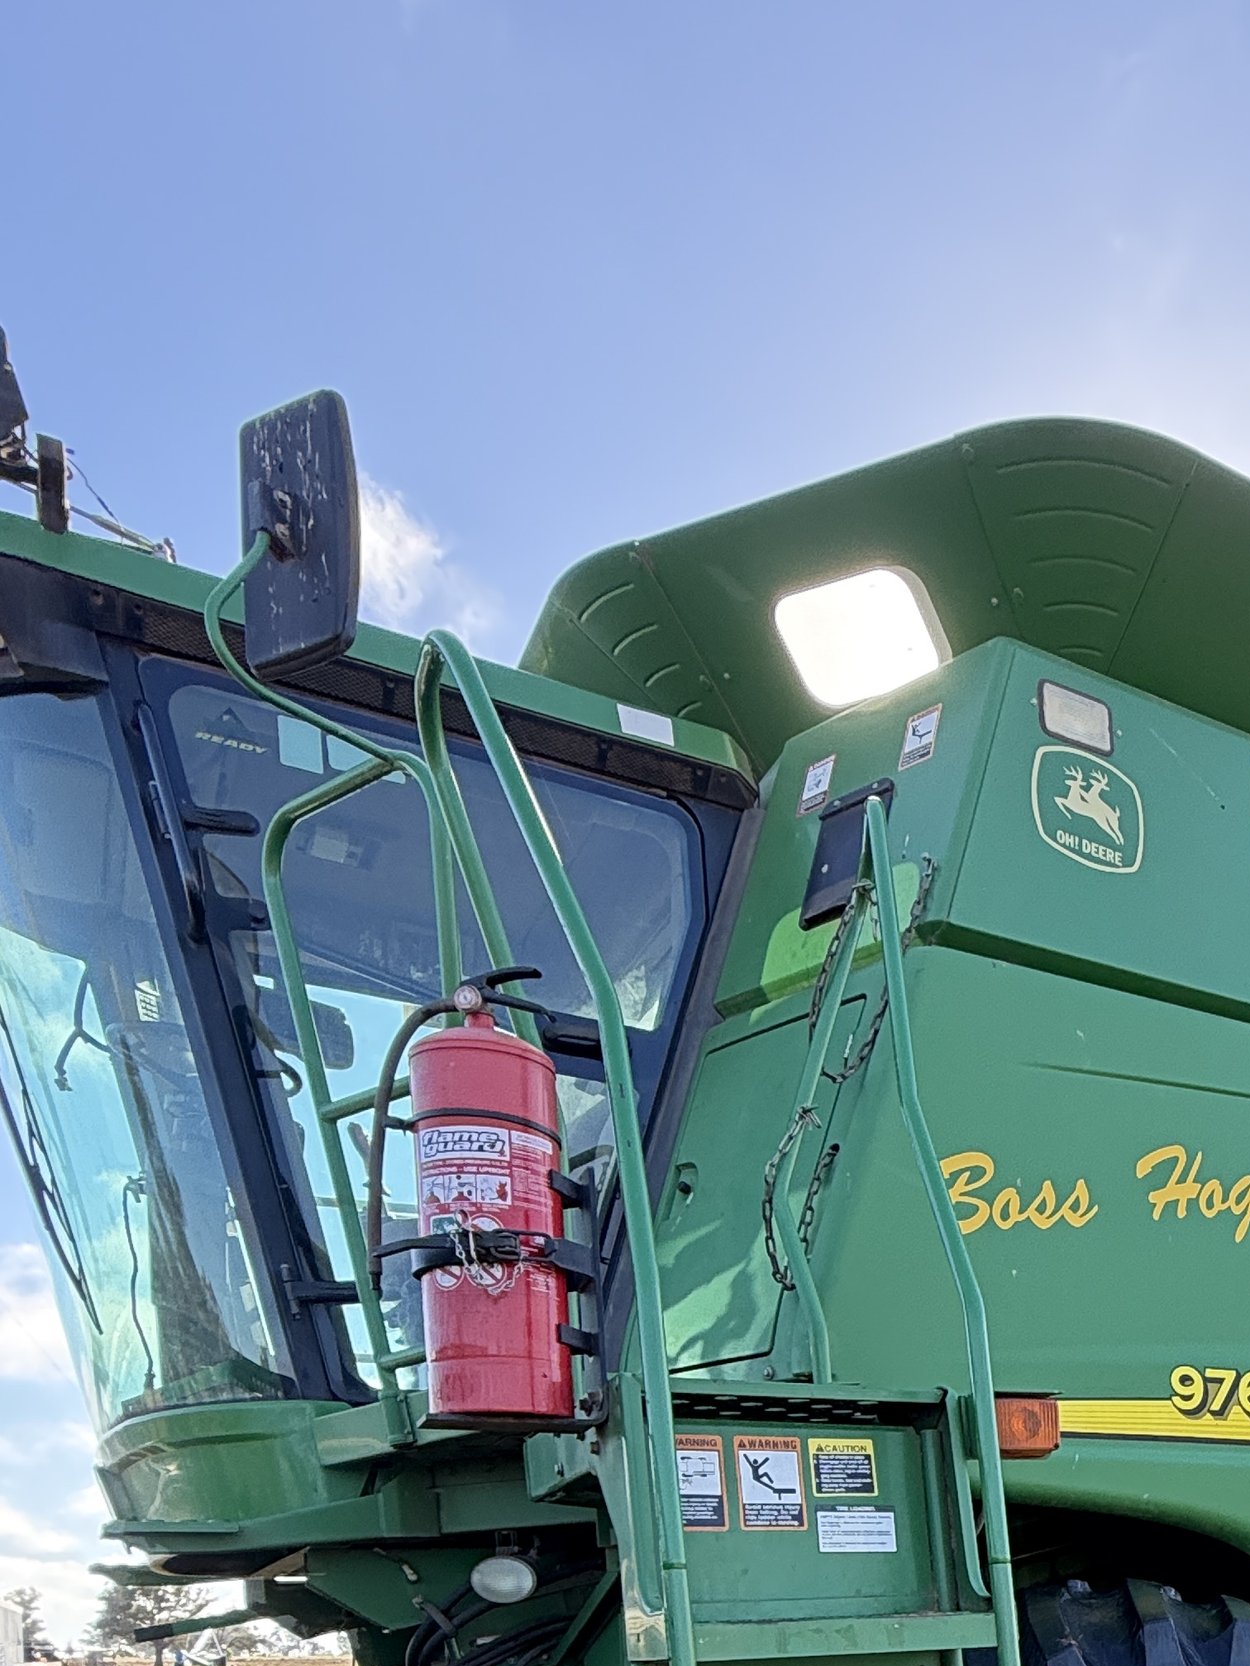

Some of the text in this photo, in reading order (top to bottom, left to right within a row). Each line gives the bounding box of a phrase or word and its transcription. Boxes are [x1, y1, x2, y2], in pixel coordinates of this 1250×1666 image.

[1056, 829, 1123, 867] OH! DEERE
[423, 1129, 498, 1146] flame
[424, 1140, 505, 1158] guard
[939, 1151, 1099, 1235] Boss
[747, 1438, 797, 1449] WARNING
[824, 1444, 867, 1453] CAUTION
